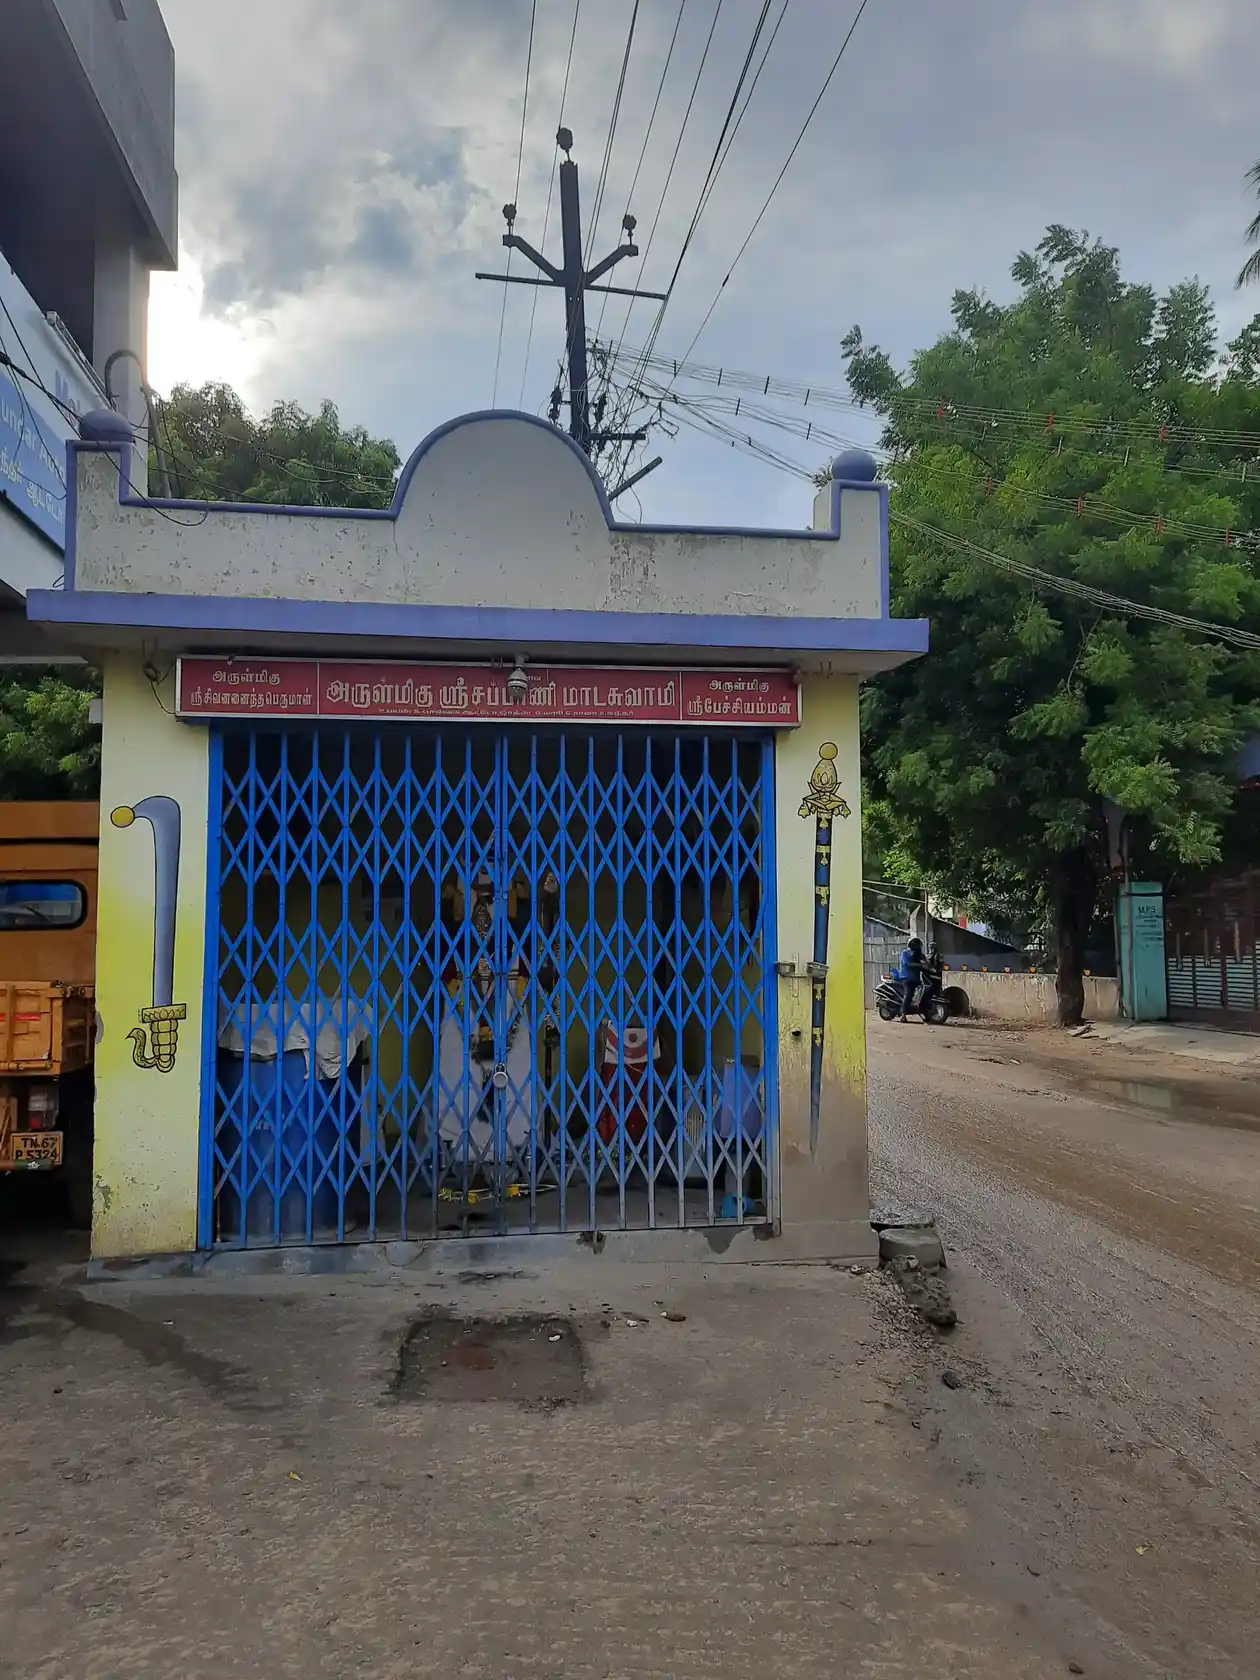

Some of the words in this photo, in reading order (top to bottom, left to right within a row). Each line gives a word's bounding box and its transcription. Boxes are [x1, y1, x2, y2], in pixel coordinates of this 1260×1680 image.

[213, 668, 280, 685] அருள்மிகு
[326, 676, 434, 708] அருள்மிகு
[709, 678, 770, 693] அருள்மிகு
